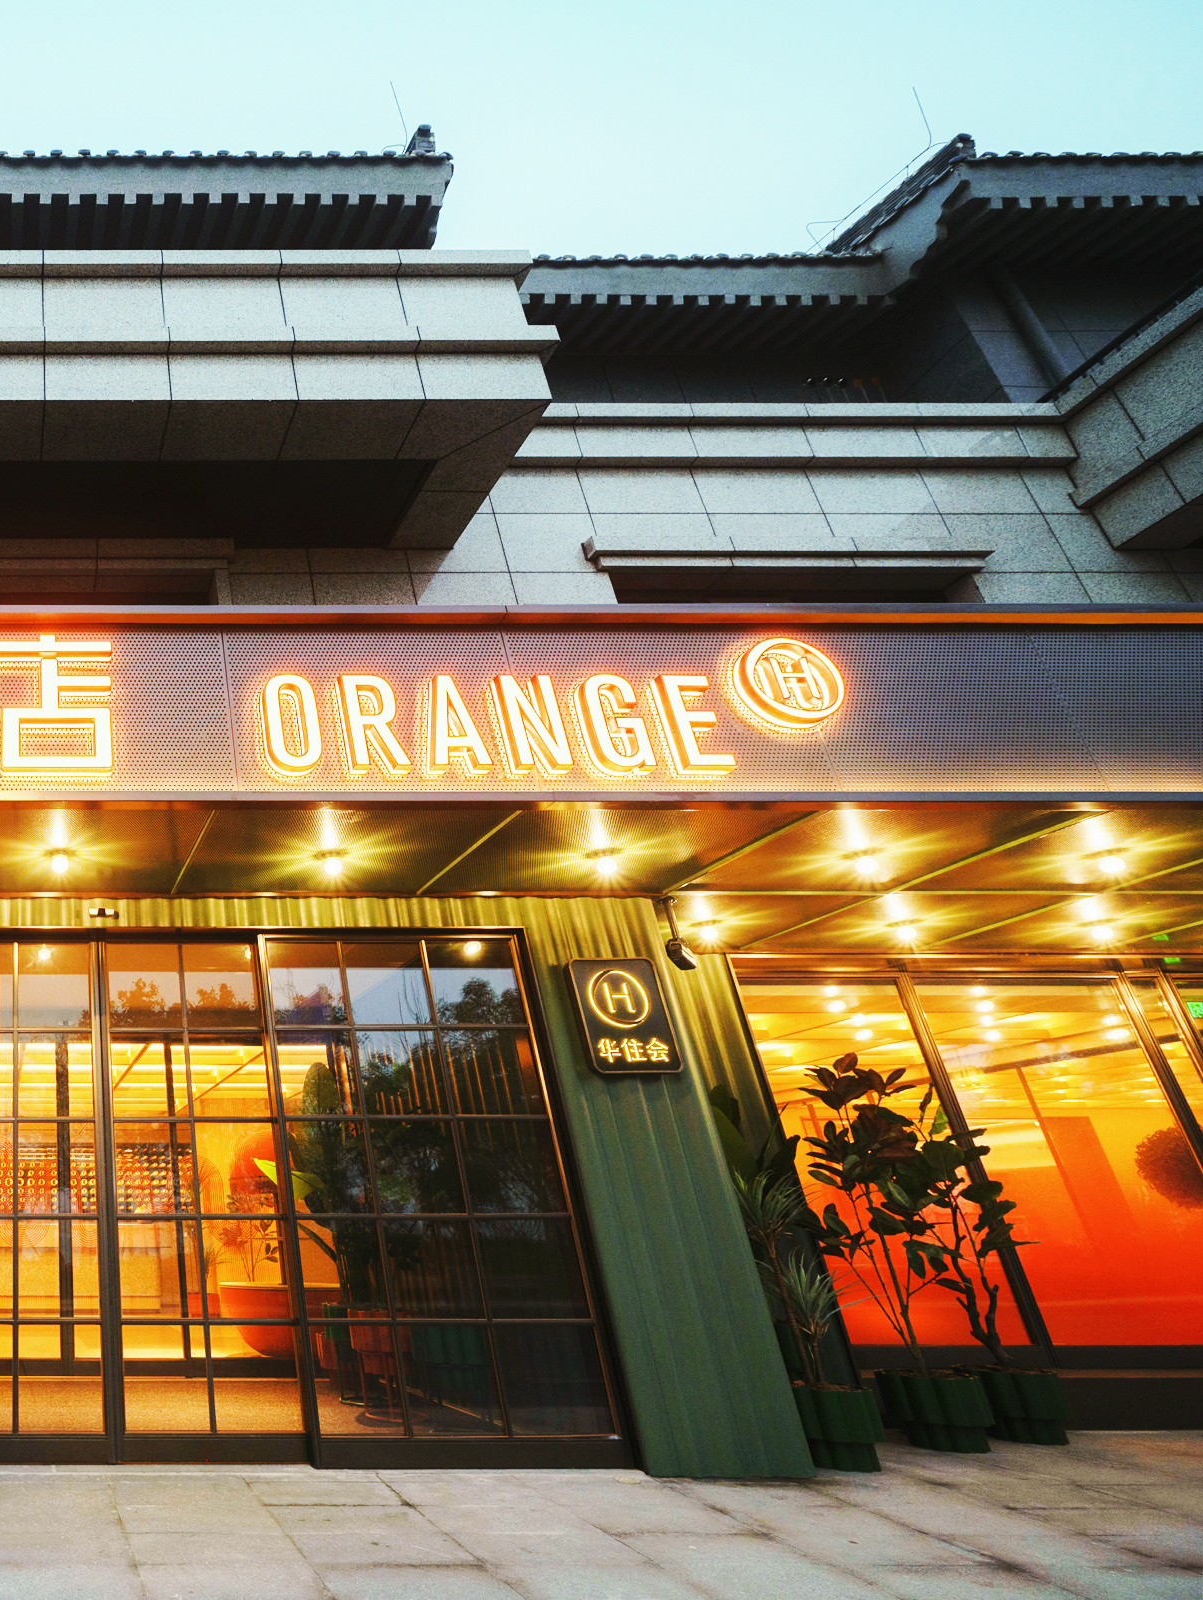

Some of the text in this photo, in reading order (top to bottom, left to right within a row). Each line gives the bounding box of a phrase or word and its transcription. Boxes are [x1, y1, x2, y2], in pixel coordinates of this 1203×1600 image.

[259, 673, 737, 777] ORANGE
[597, 1037, 670, 1063] 华住会
